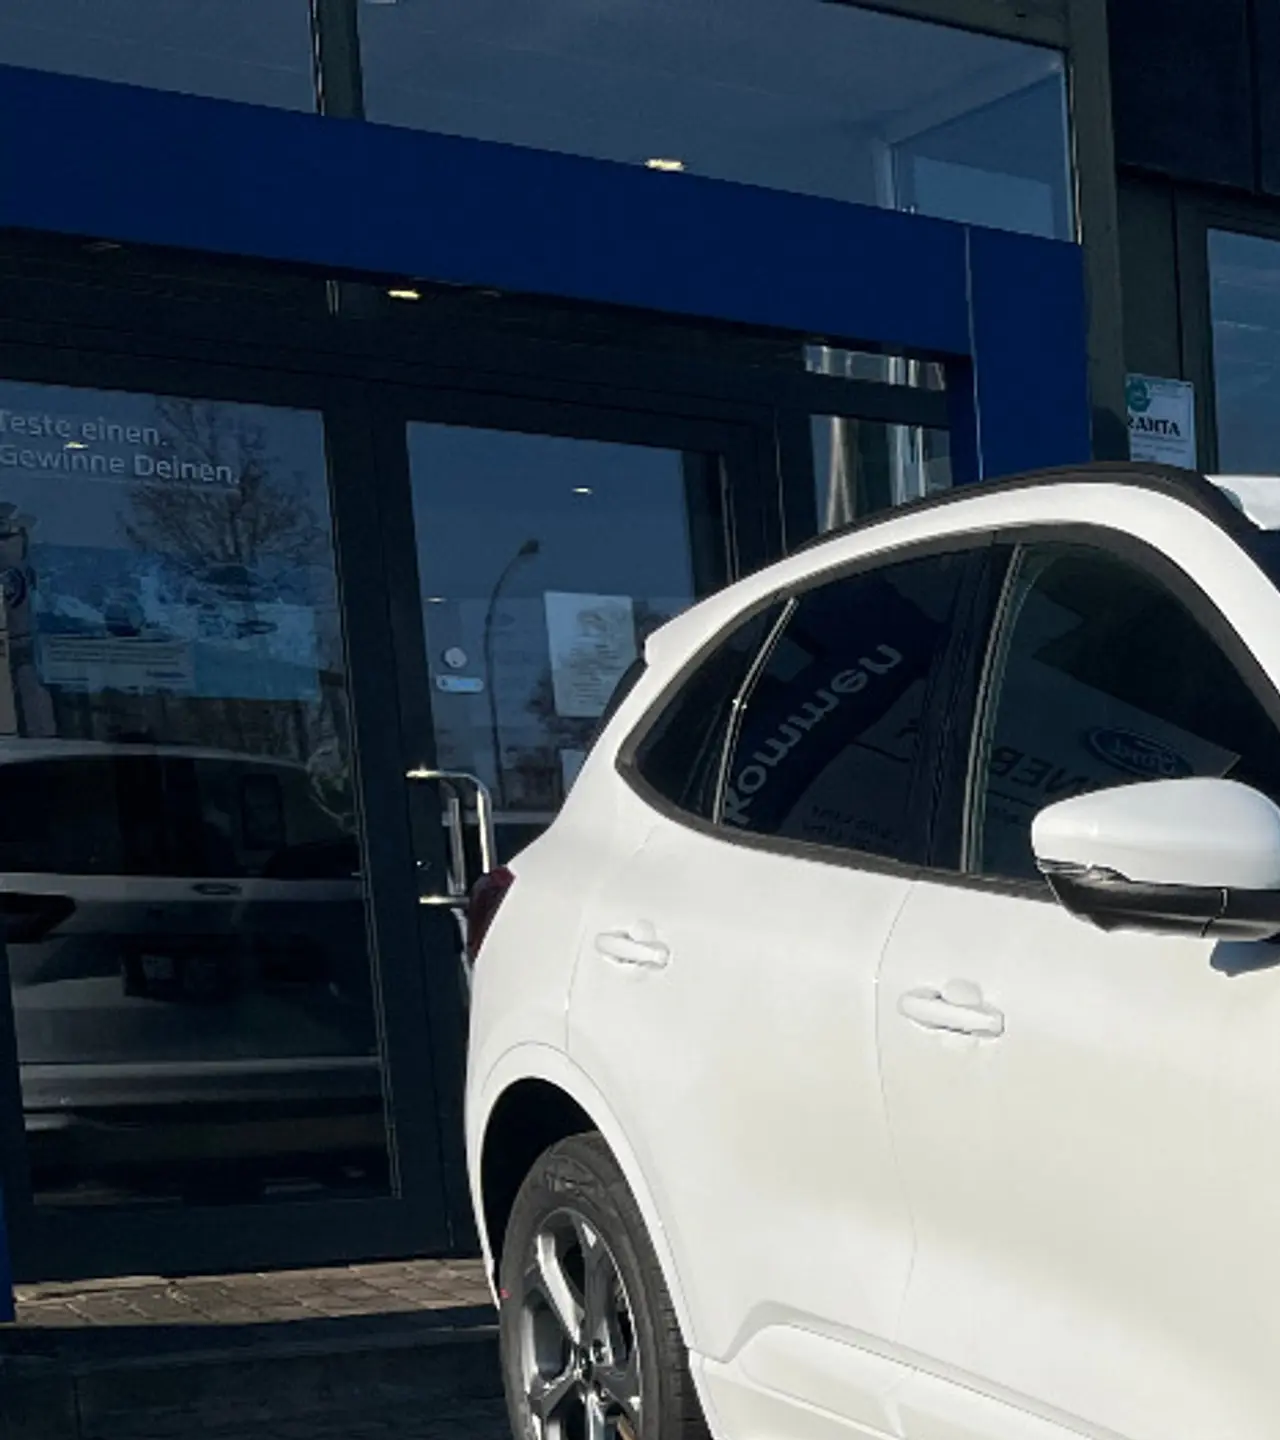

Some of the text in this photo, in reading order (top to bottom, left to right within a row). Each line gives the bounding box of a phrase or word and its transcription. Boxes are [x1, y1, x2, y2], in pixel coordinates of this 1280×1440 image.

[0, 408, 169, 447] Teste einen.
[0, 444, 241, 485] Gewinne Deinen.
